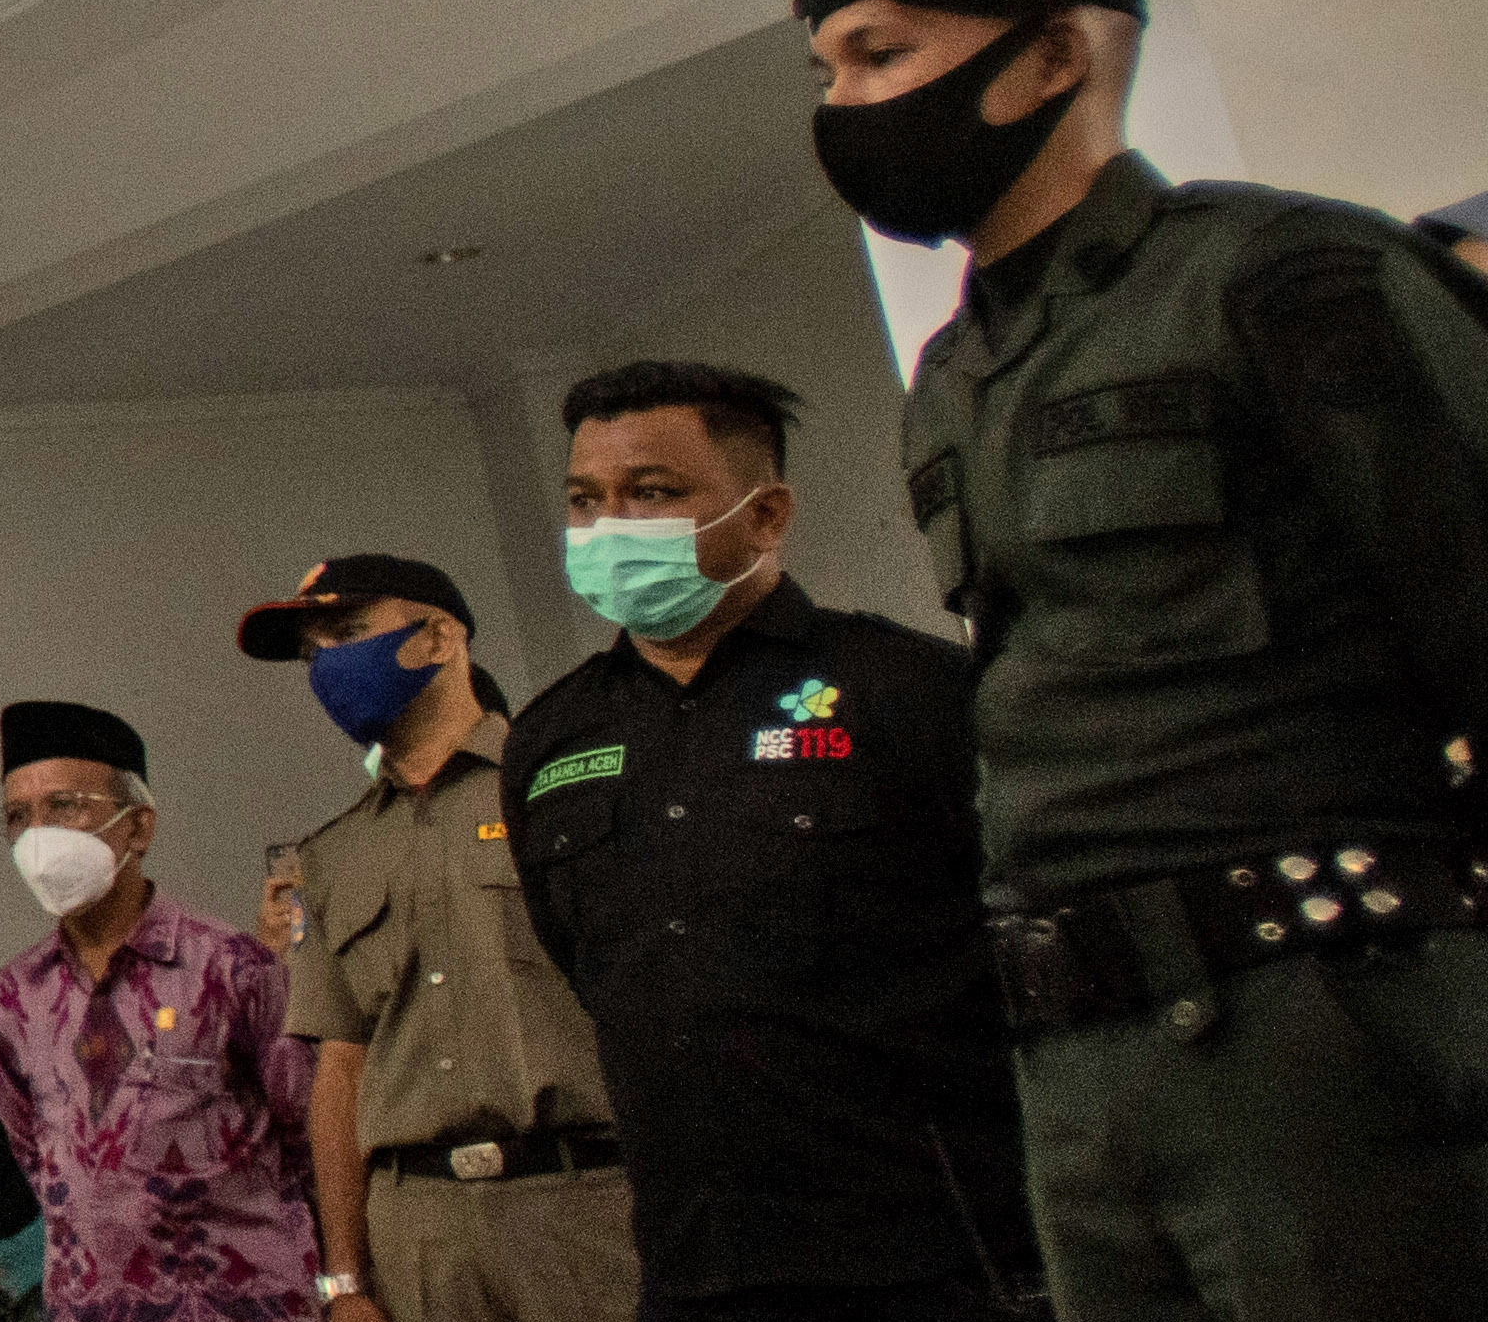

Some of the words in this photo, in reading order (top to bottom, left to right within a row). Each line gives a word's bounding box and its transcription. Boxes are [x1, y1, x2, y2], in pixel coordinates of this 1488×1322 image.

[756, 727, 794, 745] NCC
[796, 728, 852, 759] 119
[754, 743, 794, 760] PSC
[587, 752, 618, 773] ACEH
